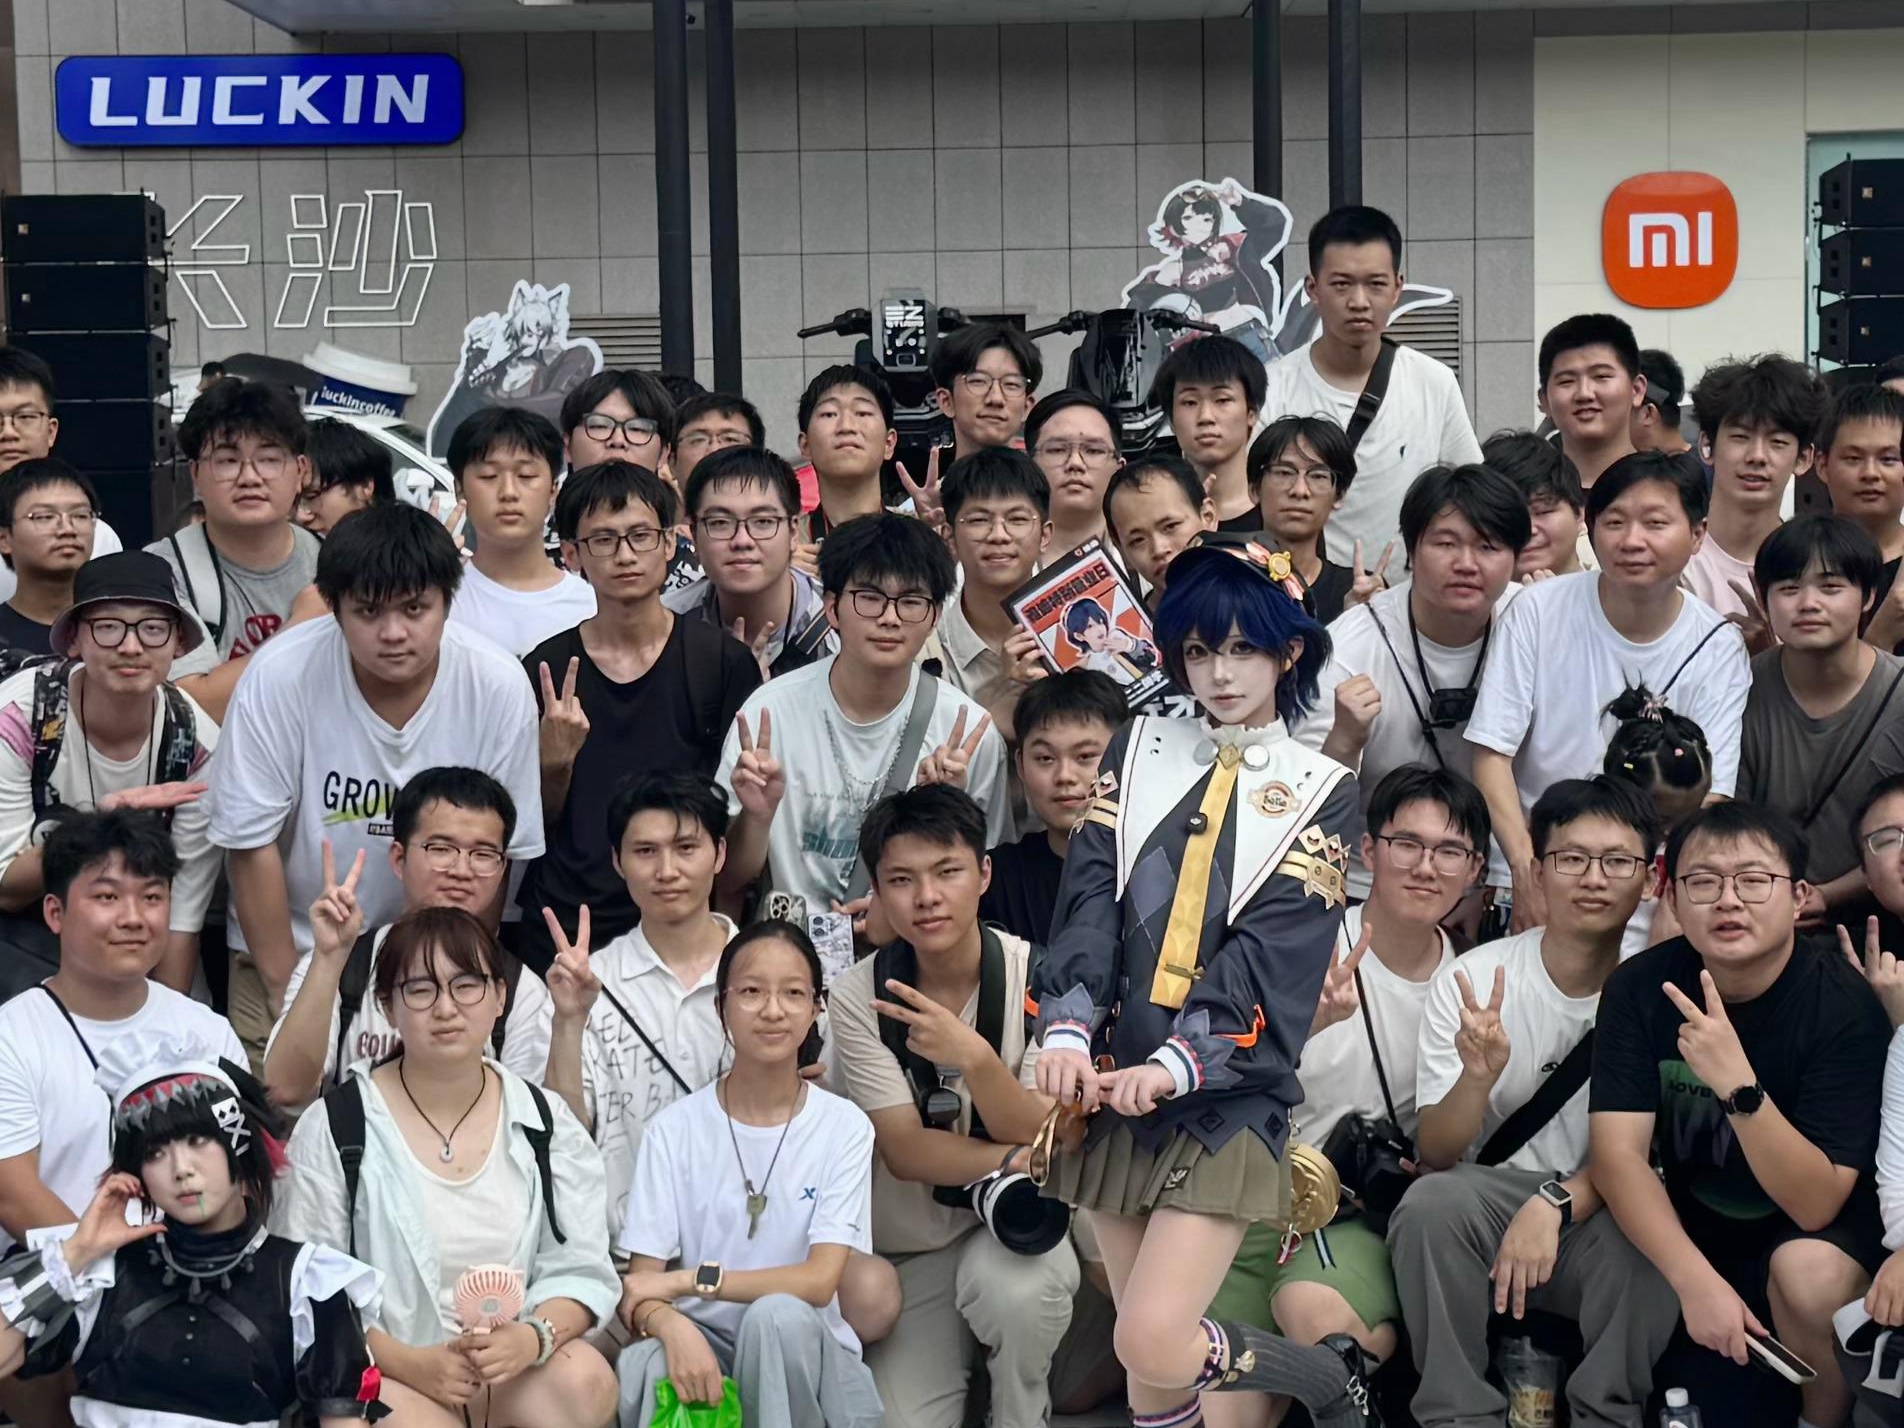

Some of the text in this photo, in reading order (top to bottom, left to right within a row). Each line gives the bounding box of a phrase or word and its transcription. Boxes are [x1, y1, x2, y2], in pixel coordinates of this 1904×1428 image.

[88, 74, 430, 126] LUCKIN
[158, 189, 438, 329] 长沙
[1628, 211, 1713, 268] mi
